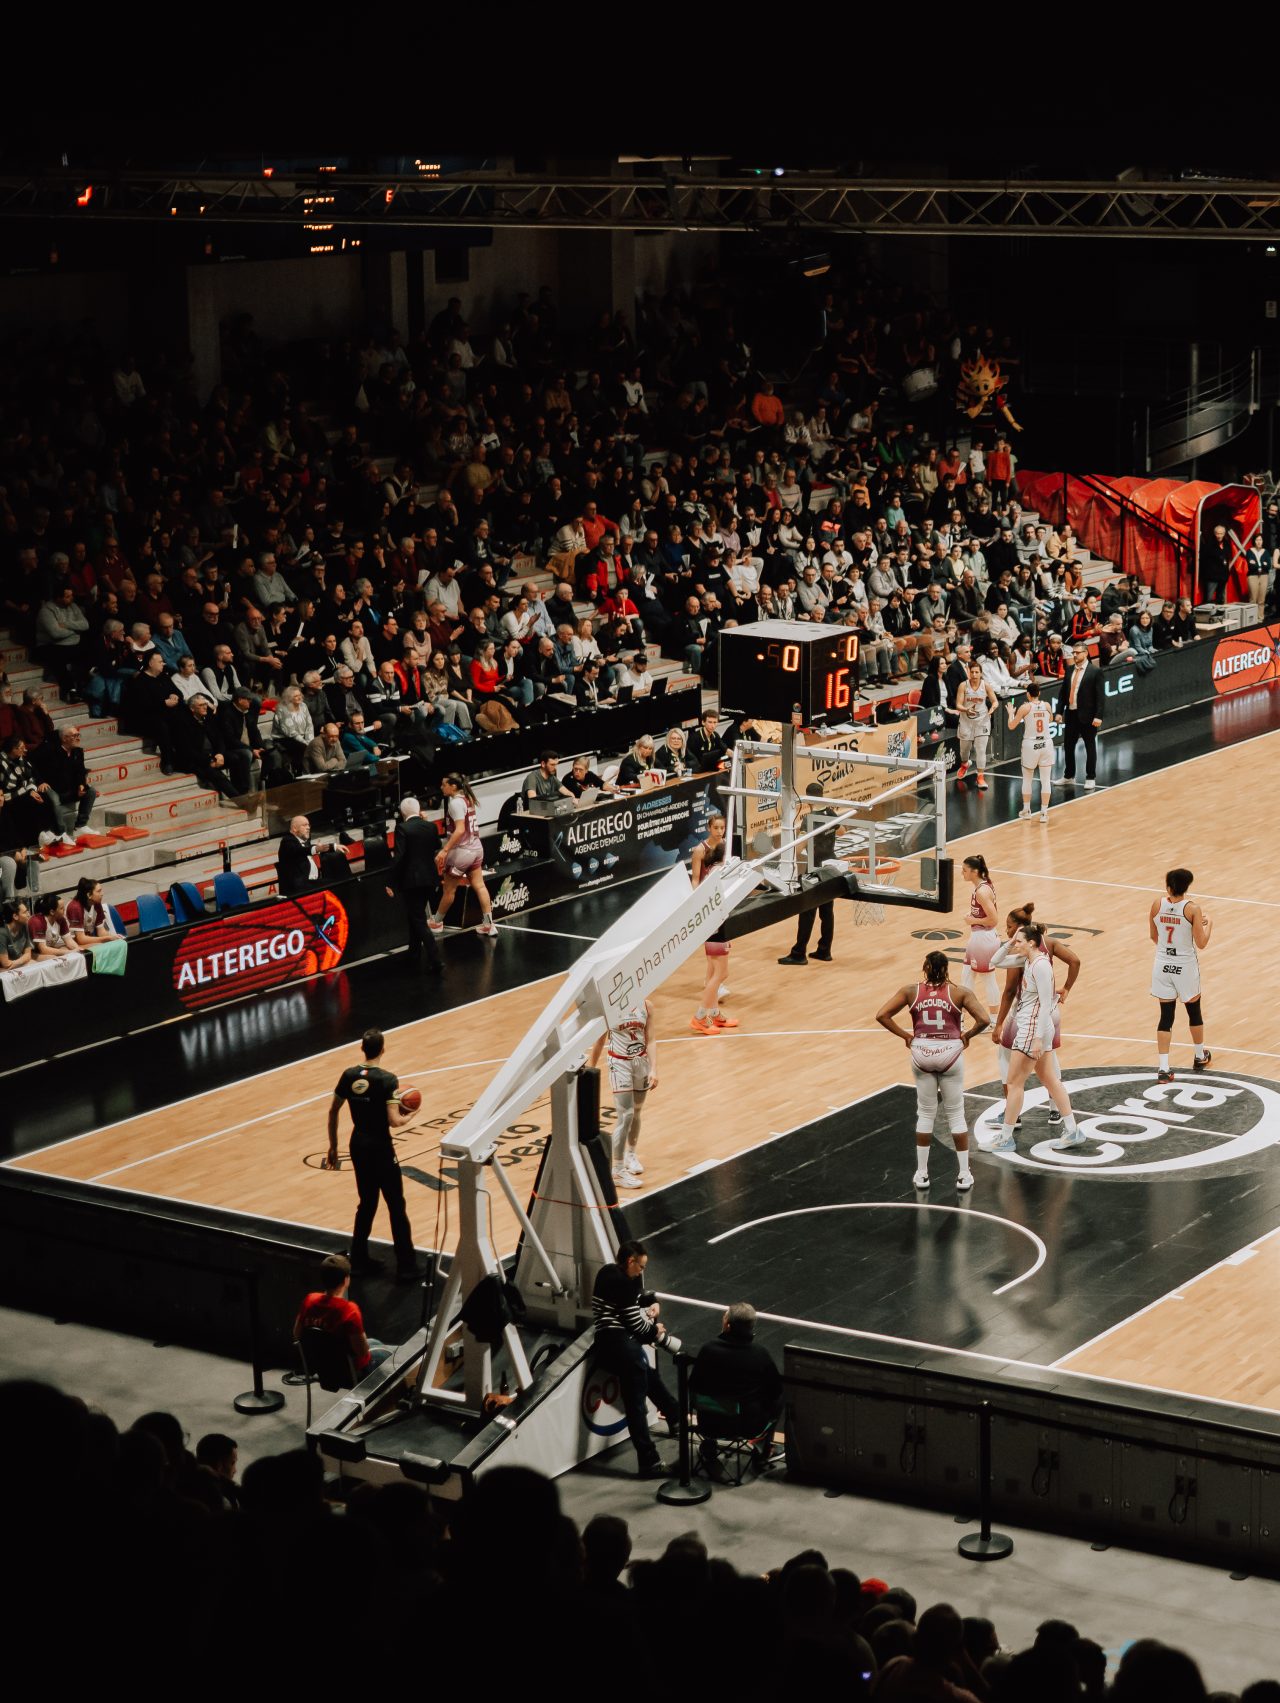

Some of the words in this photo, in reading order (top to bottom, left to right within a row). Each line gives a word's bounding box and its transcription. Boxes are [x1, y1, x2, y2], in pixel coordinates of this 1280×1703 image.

[1213, 646, 1270, 679] ALTEREGO
[825, 668, 850, 709] 16
[118, 765, 129, 781] D
[168, 803, 178, 818] C
[567, 810, 633, 847] ALTEREGO
[574, 840, 600, 856] AGENCE
[268, 884, 277, 895] A
[635, 885, 722, 988] pharmasanté
[1165, 926, 1175, 945] 7
[177, 929, 305, 990] ALTEREGO
[922, 1010, 946, 1031] 4
[1029, 1082, 1245, 1165] cora
